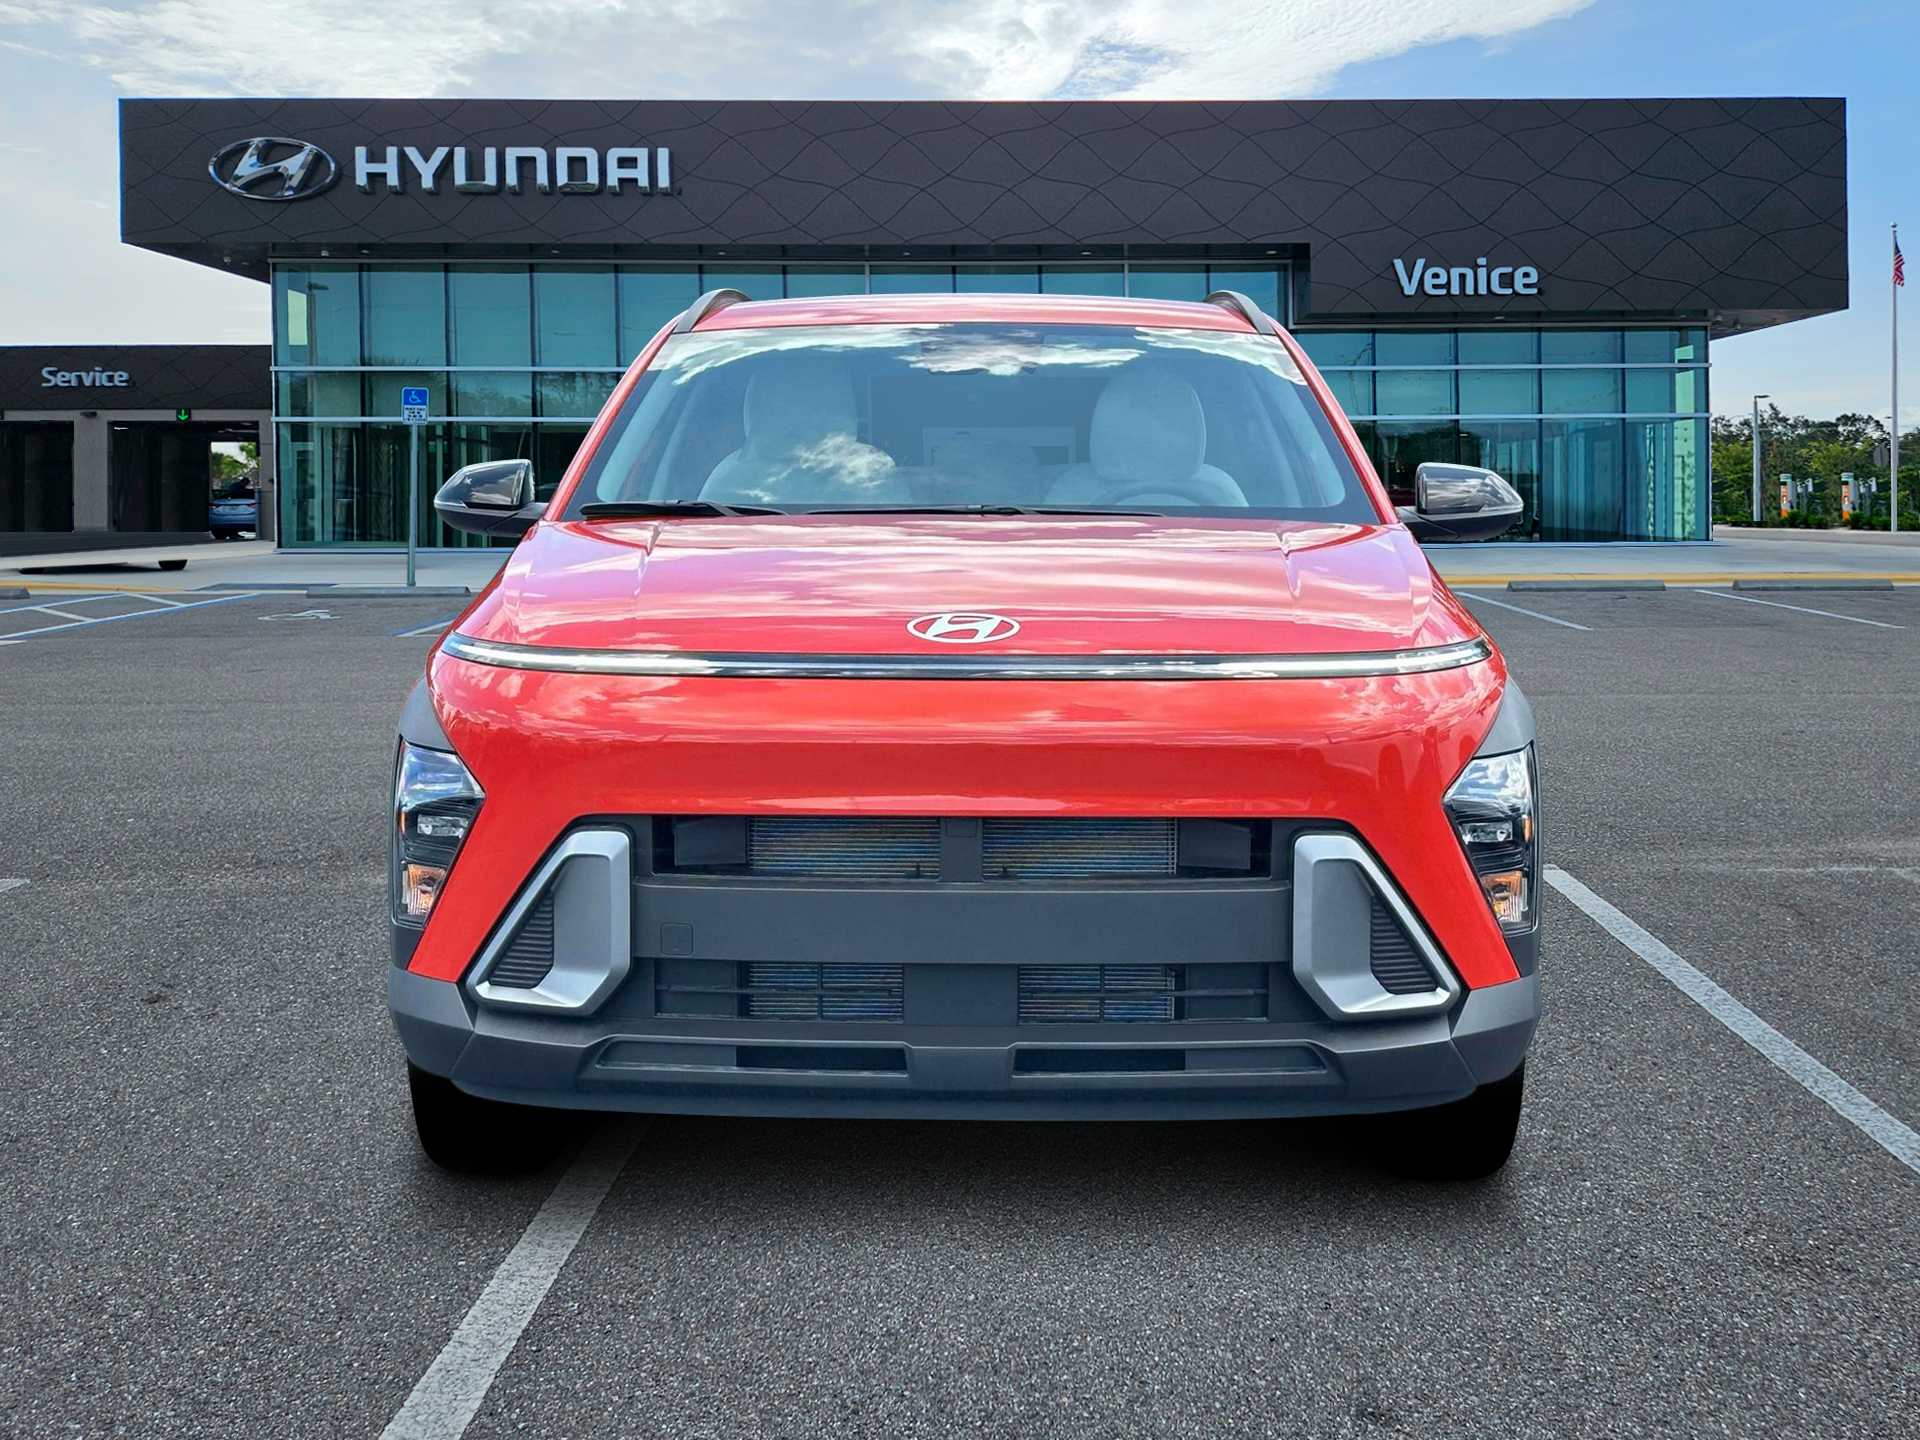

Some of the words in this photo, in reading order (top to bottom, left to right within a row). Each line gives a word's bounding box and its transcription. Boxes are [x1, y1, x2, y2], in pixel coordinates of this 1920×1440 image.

[354, 146, 670, 195] HYUNDAI
[1392, 257, 1539, 296] Venice
[41, 366, 130, 387] Service
